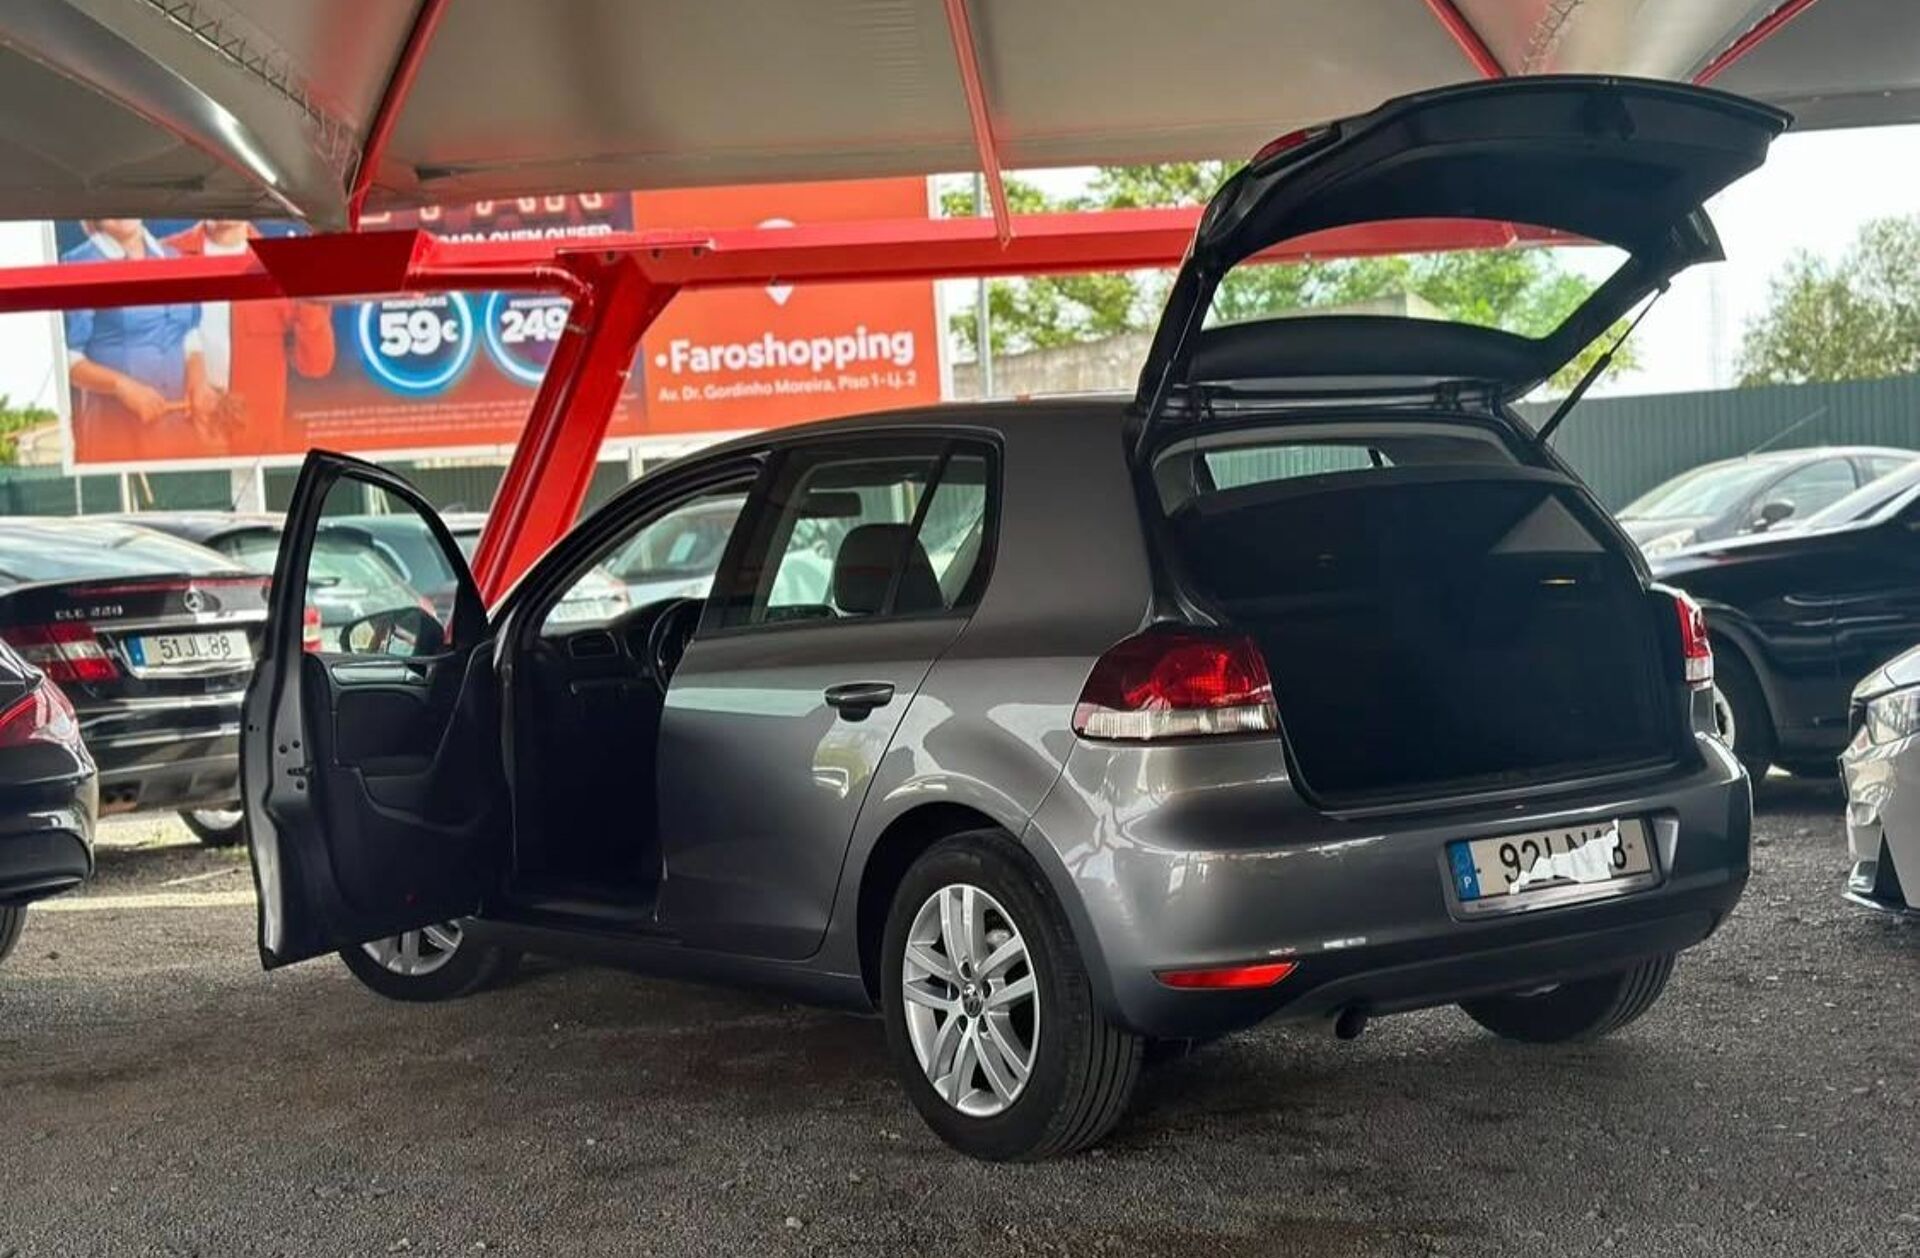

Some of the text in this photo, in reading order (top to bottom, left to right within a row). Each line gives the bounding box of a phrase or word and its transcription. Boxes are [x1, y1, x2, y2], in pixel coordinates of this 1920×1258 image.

[380, 310, 458, 357] 59€
[669, 325, 914, 375] Faroshopping
[658, 386, 680, 402] Av.
[682, 384, 702, 401] Dr.
[703, 380, 773, 400] Gordinho
[775, 376, 835, 396] Moreira,
[838, 373, 870, 390] Piso
